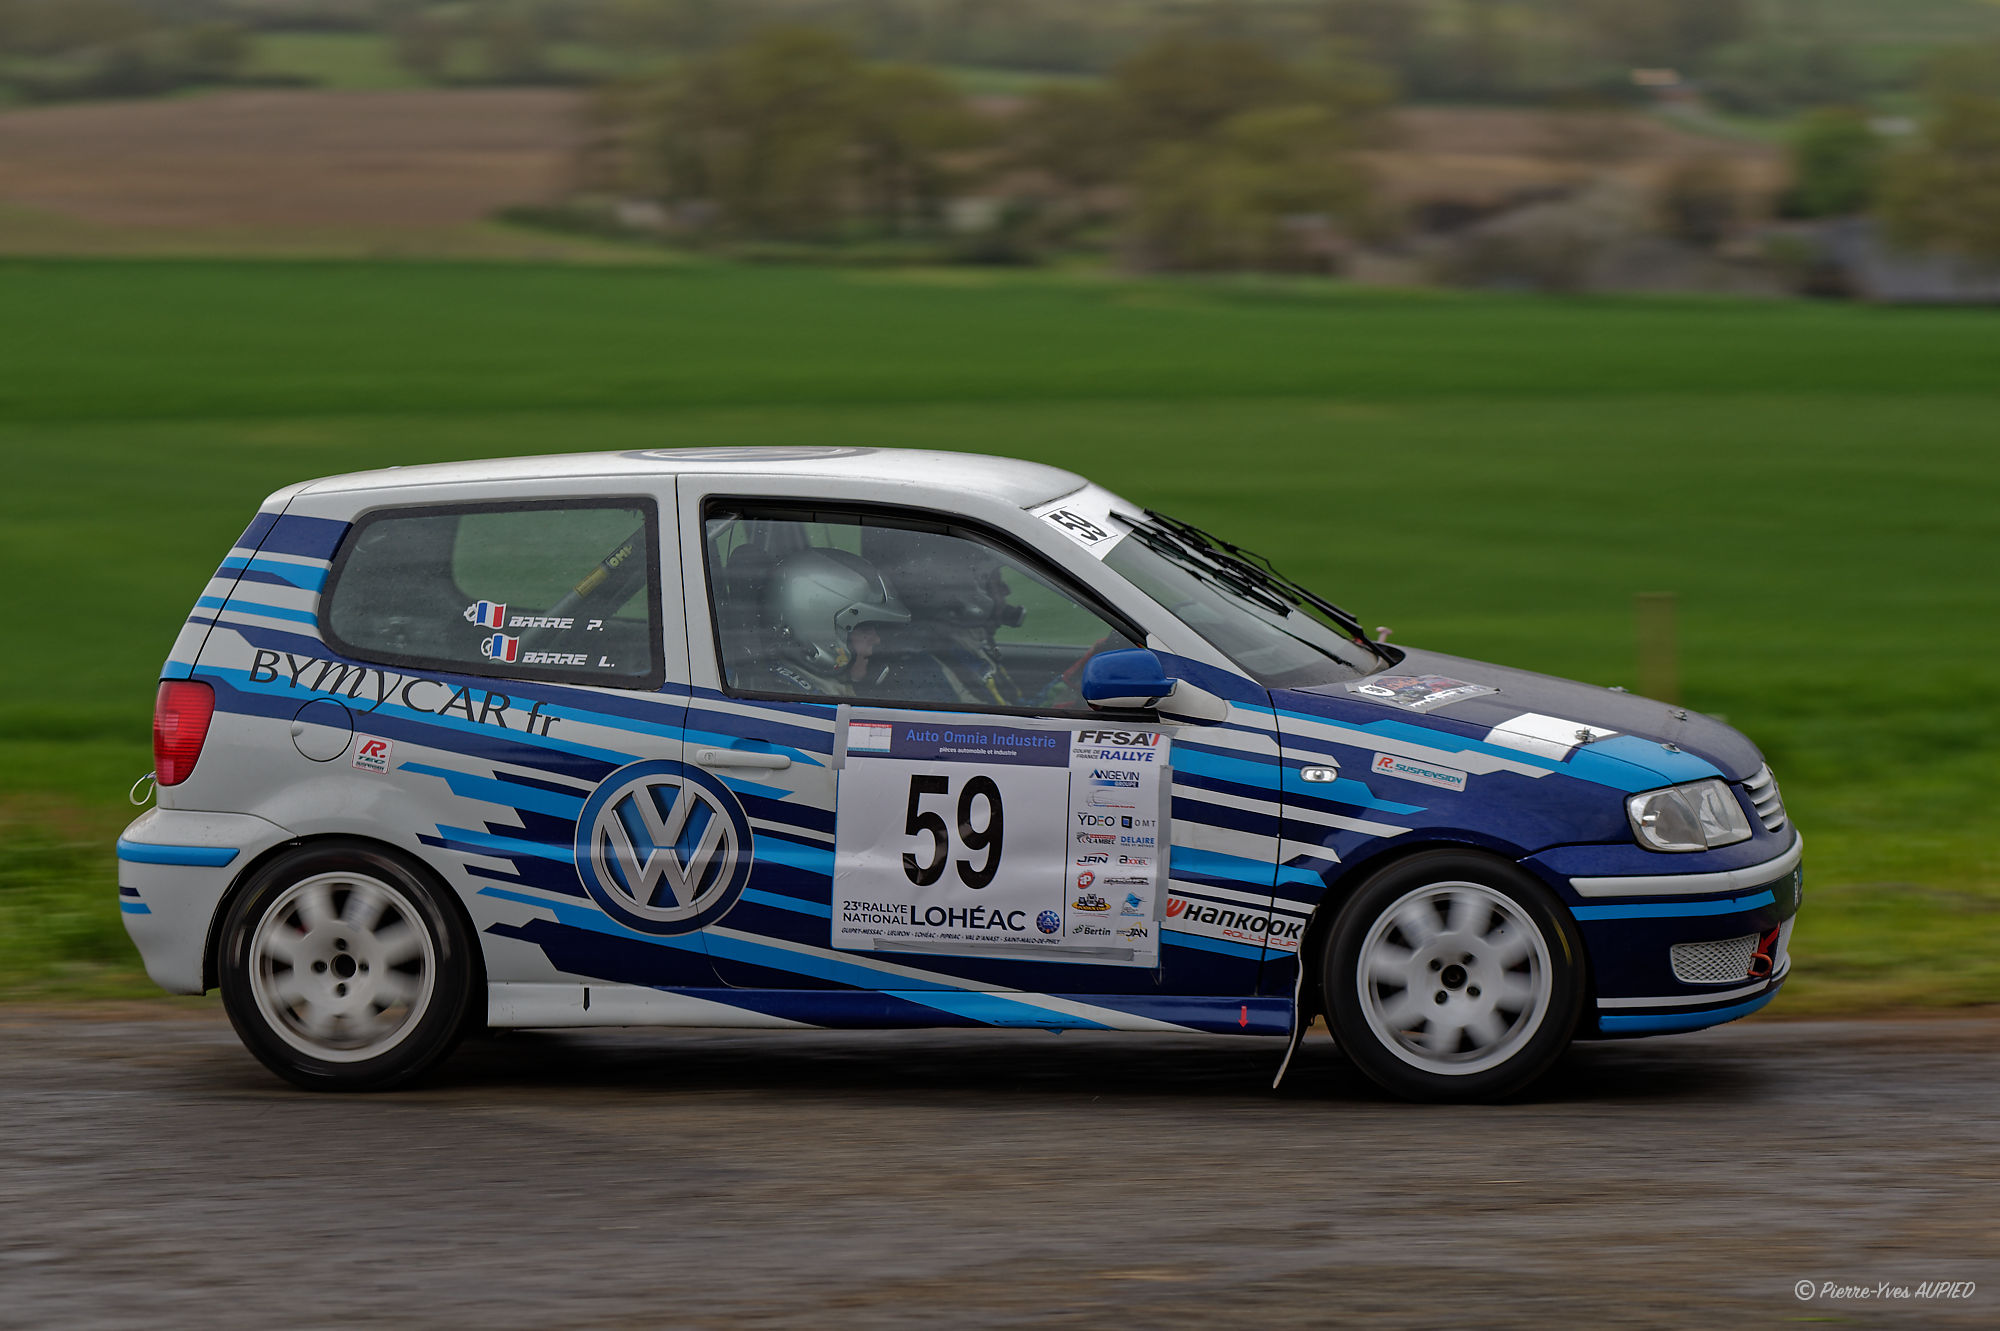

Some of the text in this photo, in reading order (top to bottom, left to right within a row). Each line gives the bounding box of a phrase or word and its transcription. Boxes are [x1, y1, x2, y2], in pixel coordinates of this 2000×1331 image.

[1049, 510, 1107, 541] 59
[509, 616, 604, 632] BARRE P.
[522, 652, 615, 667] BARRE L.
[526, 702, 561, 737] fr
[906, 729, 1056, 748] Auto Omnia Industrie
[1077, 730, 1150, 747] FFSA
[1100, 750, 1155, 762] RALLYE
[1088, 769, 1140, 780] ANGEVIN
[1395, 763, 1463, 785] SUSPENSION
[1078, 815, 1115, 826] YDEO
[902, 774, 1004, 890] 59
[1121, 835, 1155, 844] DELAIRE
[862, 902, 908, 913] RALLYE
[843, 913, 908, 925] NATIONAL
[911, 905, 1026, 931] LOHÉAC
[1084, 927, 1111, 936] Bertin
[1126, 928, 1148, 938] JAN
[1270, 936, 1298, 947] CUP
